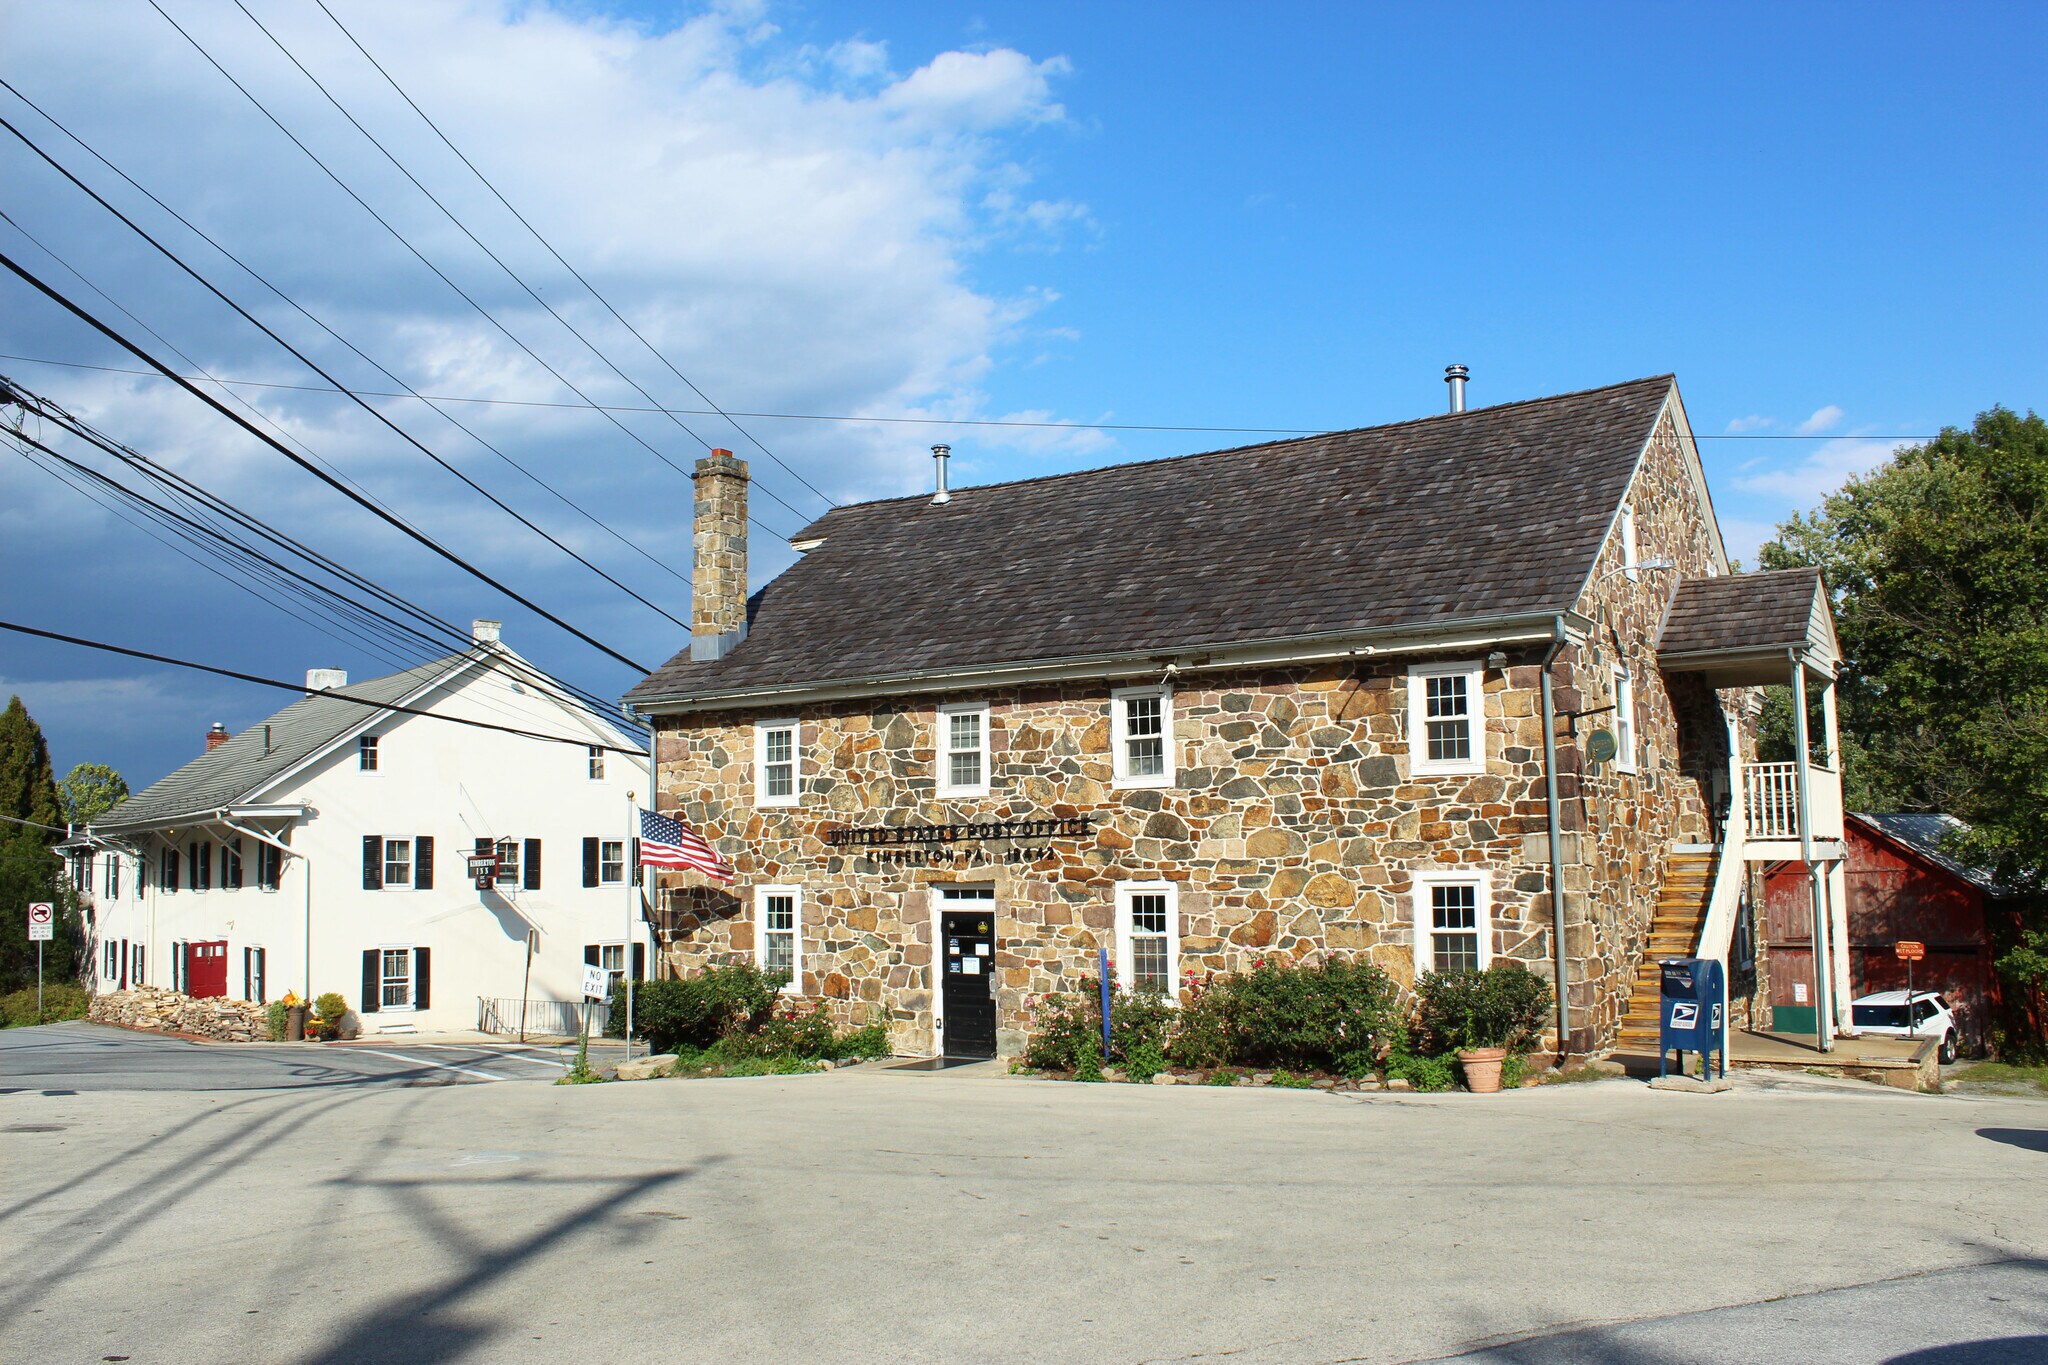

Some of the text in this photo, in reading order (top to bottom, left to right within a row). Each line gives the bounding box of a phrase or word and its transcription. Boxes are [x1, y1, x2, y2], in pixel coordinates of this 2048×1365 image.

[829, 817, 1091, 845] UNITED STATES POST OFFICE
[589, 970, 602, 981] NO
[584, 981, 603, 995] EXIT
